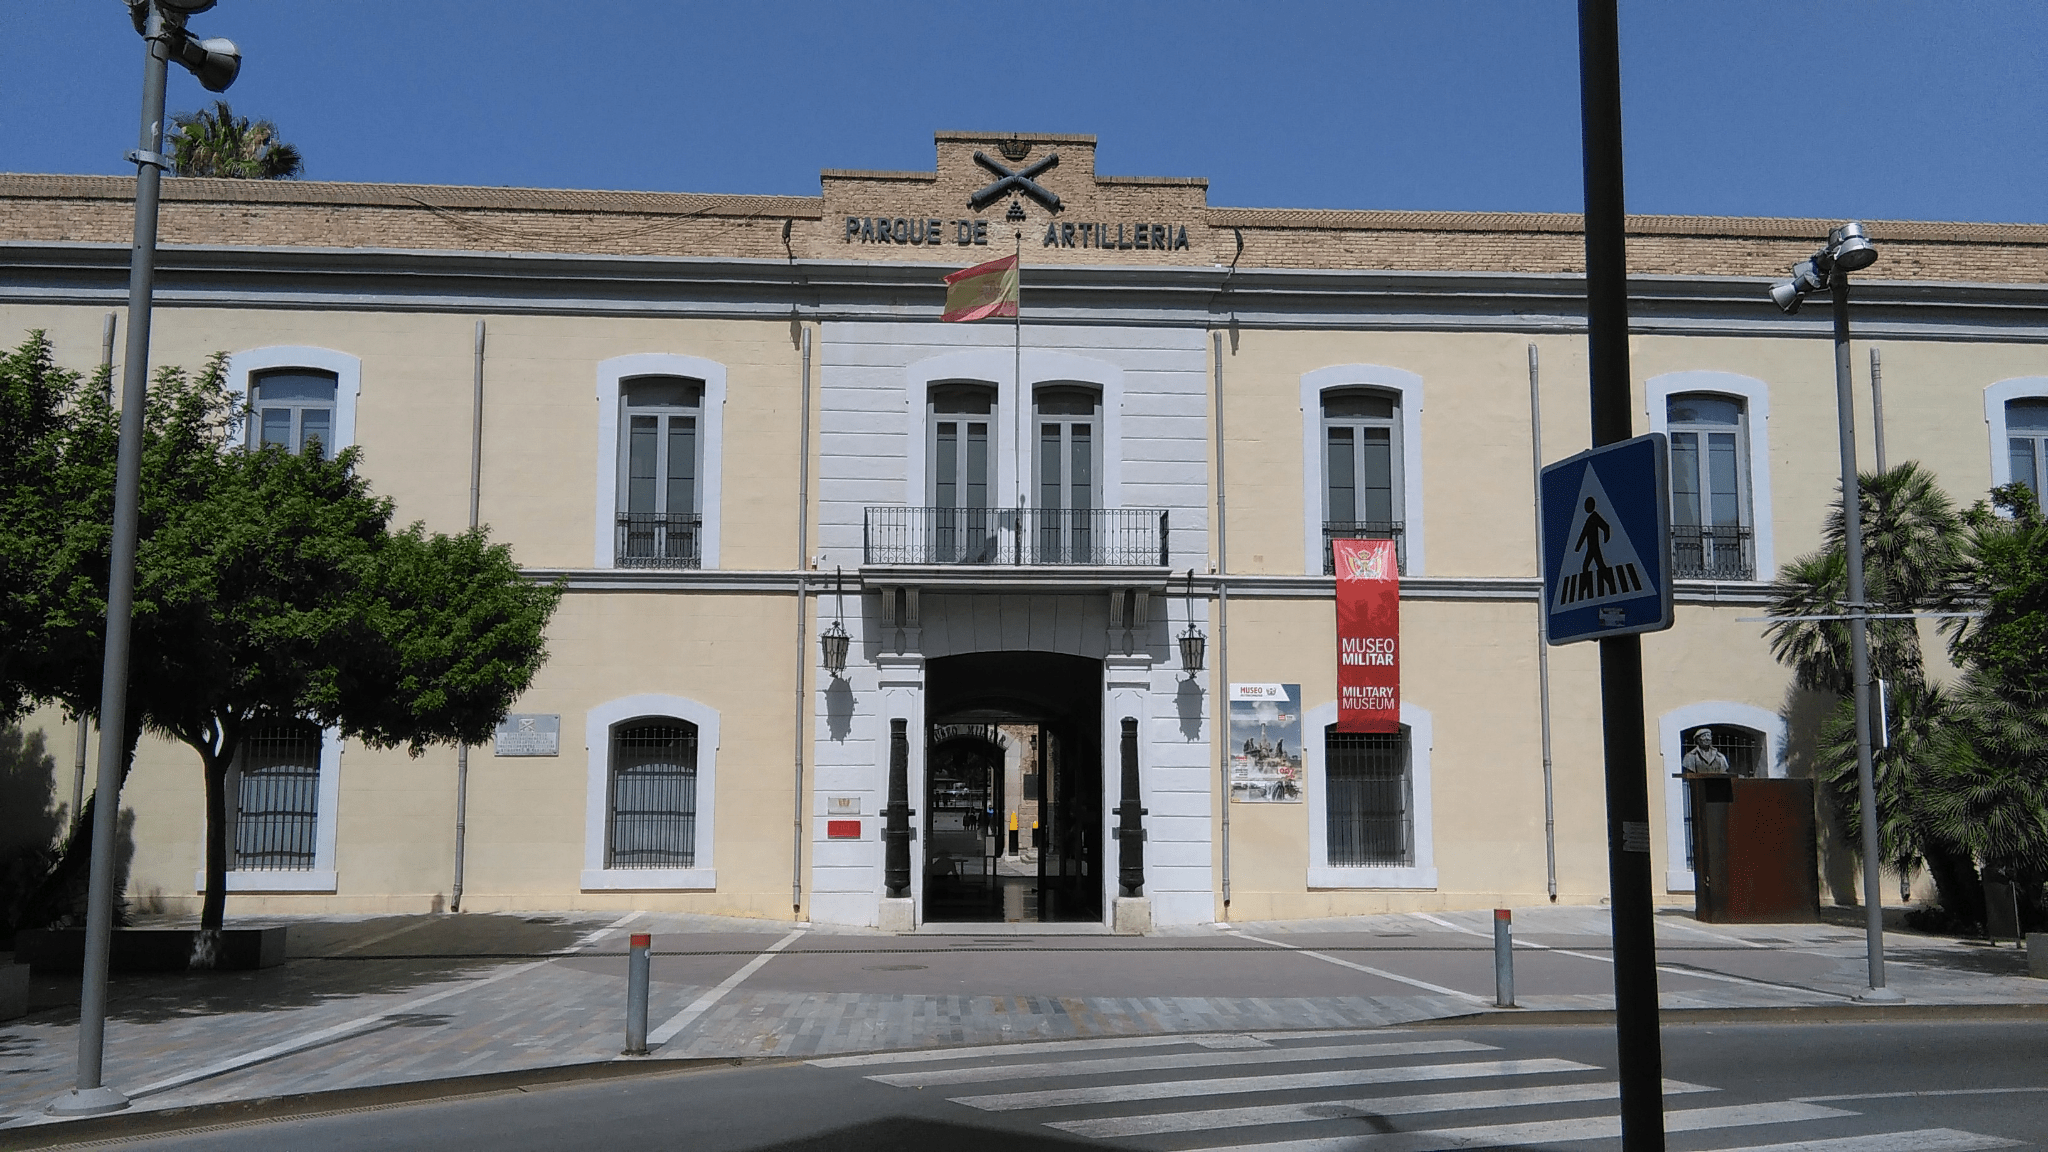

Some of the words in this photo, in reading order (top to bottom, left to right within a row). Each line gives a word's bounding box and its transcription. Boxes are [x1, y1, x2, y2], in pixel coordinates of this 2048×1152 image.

[846, 216, 941, 245] PARQUE
[957, 219, 988, 246] DE
[1043, 221, 1189, 251] ARTILLERIA
[1342, 637, 1395, 653] MUSEO
[1342, 653, 1395, 666] MILITAR
[1240, 686, 1263, 694] MUSEO
[1342, 686, 1394, 698] MILITARY
[1342, 698, 1395, 710] MUSEUM
[934, 726, 958, 743] USEO
